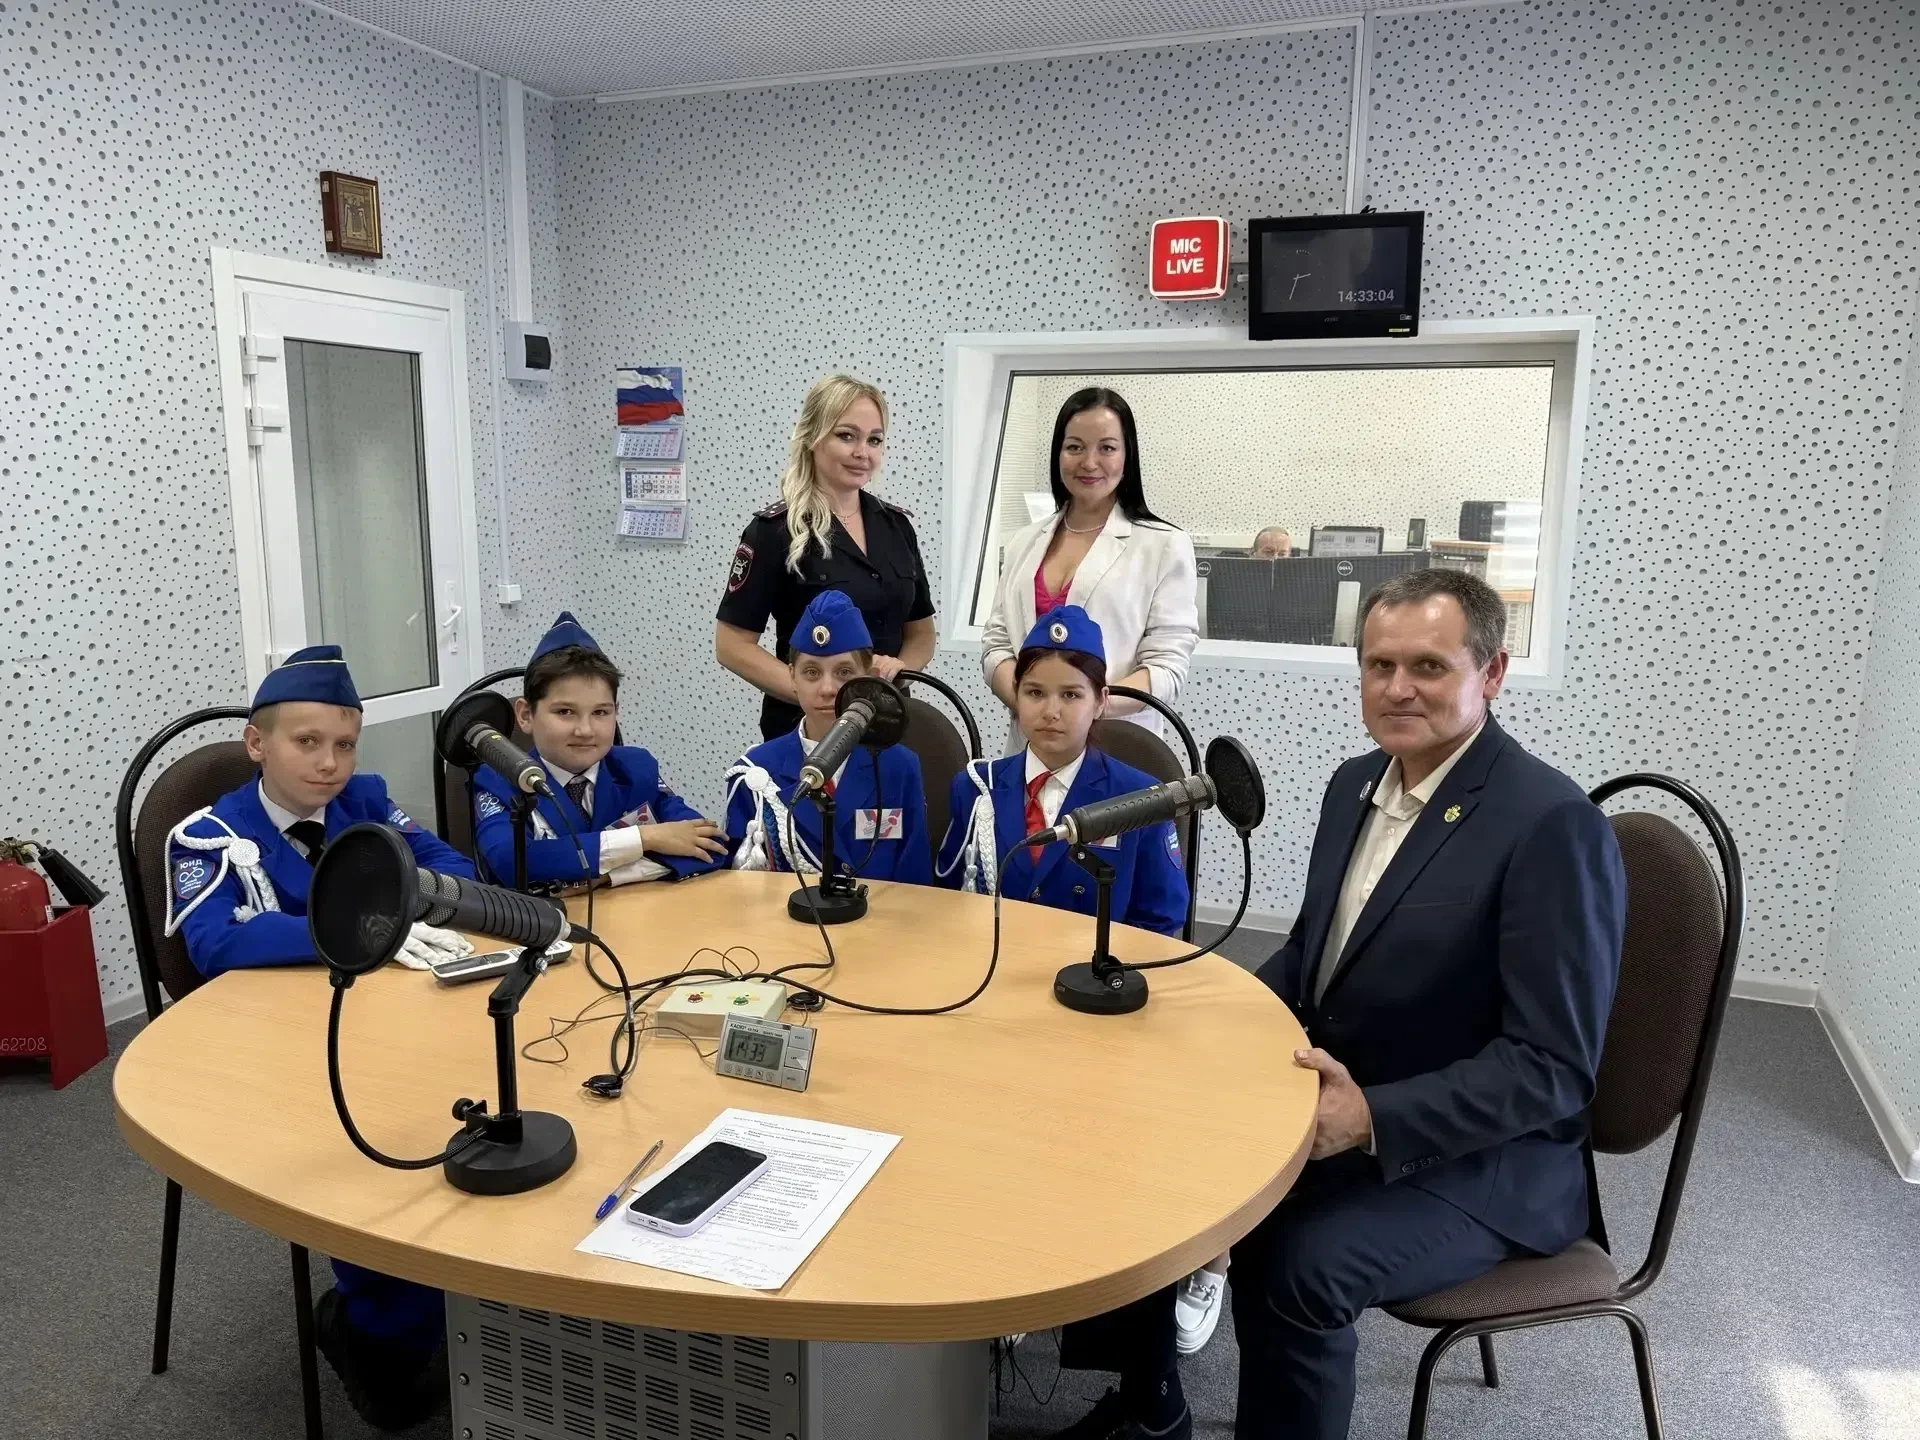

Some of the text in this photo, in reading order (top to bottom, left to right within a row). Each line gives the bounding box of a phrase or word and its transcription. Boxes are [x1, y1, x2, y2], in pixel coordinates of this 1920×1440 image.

[1170, 237, 1202, 254] MIC
[1166, 257, 1204, 275] LIVE
[1338, 289, 1395, 303] 14:33:04
[180, 859, 203, 869] ЮИД
[0, 1036, 48, 1051] 62708
